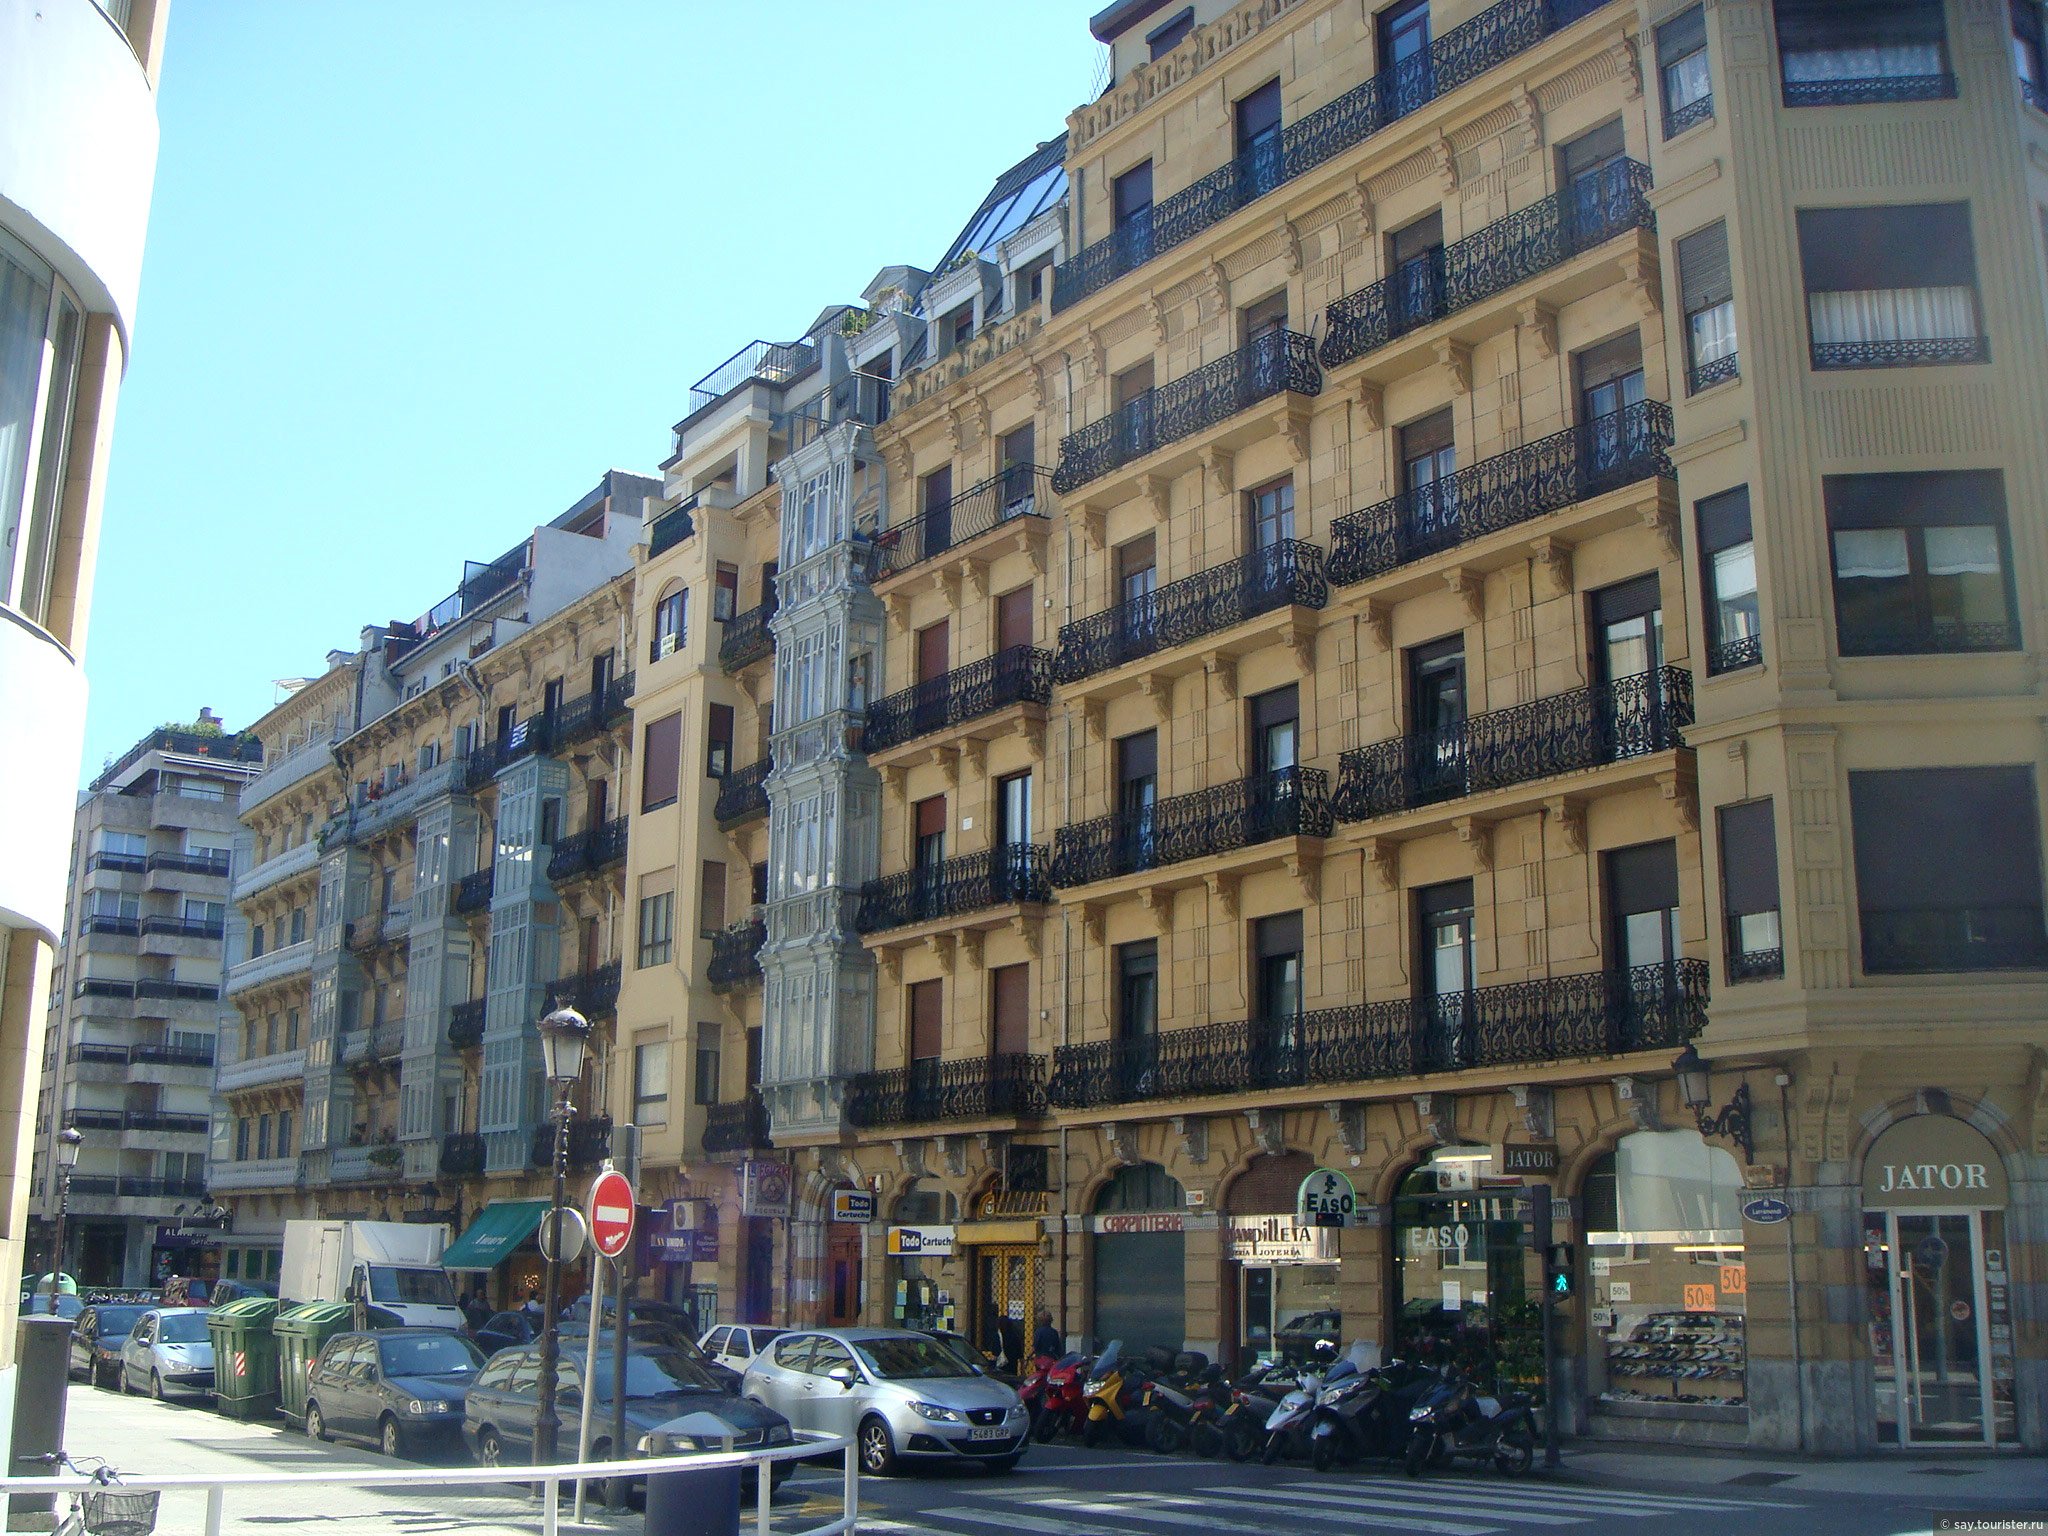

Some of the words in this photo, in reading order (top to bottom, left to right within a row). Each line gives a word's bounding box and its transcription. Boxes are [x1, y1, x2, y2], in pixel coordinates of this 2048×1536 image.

[1507, 1151, 1554, 1168] JATOR
[1880, 1164, 1990, 1192] JATOR
[850, 1199, 869, 1208] Todo
[1306, 1193, 1353, 1214] EASO
[901, 1235, 920, 1247] Todo
[922, 1236, 953, 1246] Cartuch
[1411, 1224, 1469, 1248] EASO
[20, 1291, 31, 1304] P
[1612, 1285, 1629, 1297] 50%
[1686, 1287, 1715, 1309] 50%
[1593, 1312, 1610, 1322] 50%
